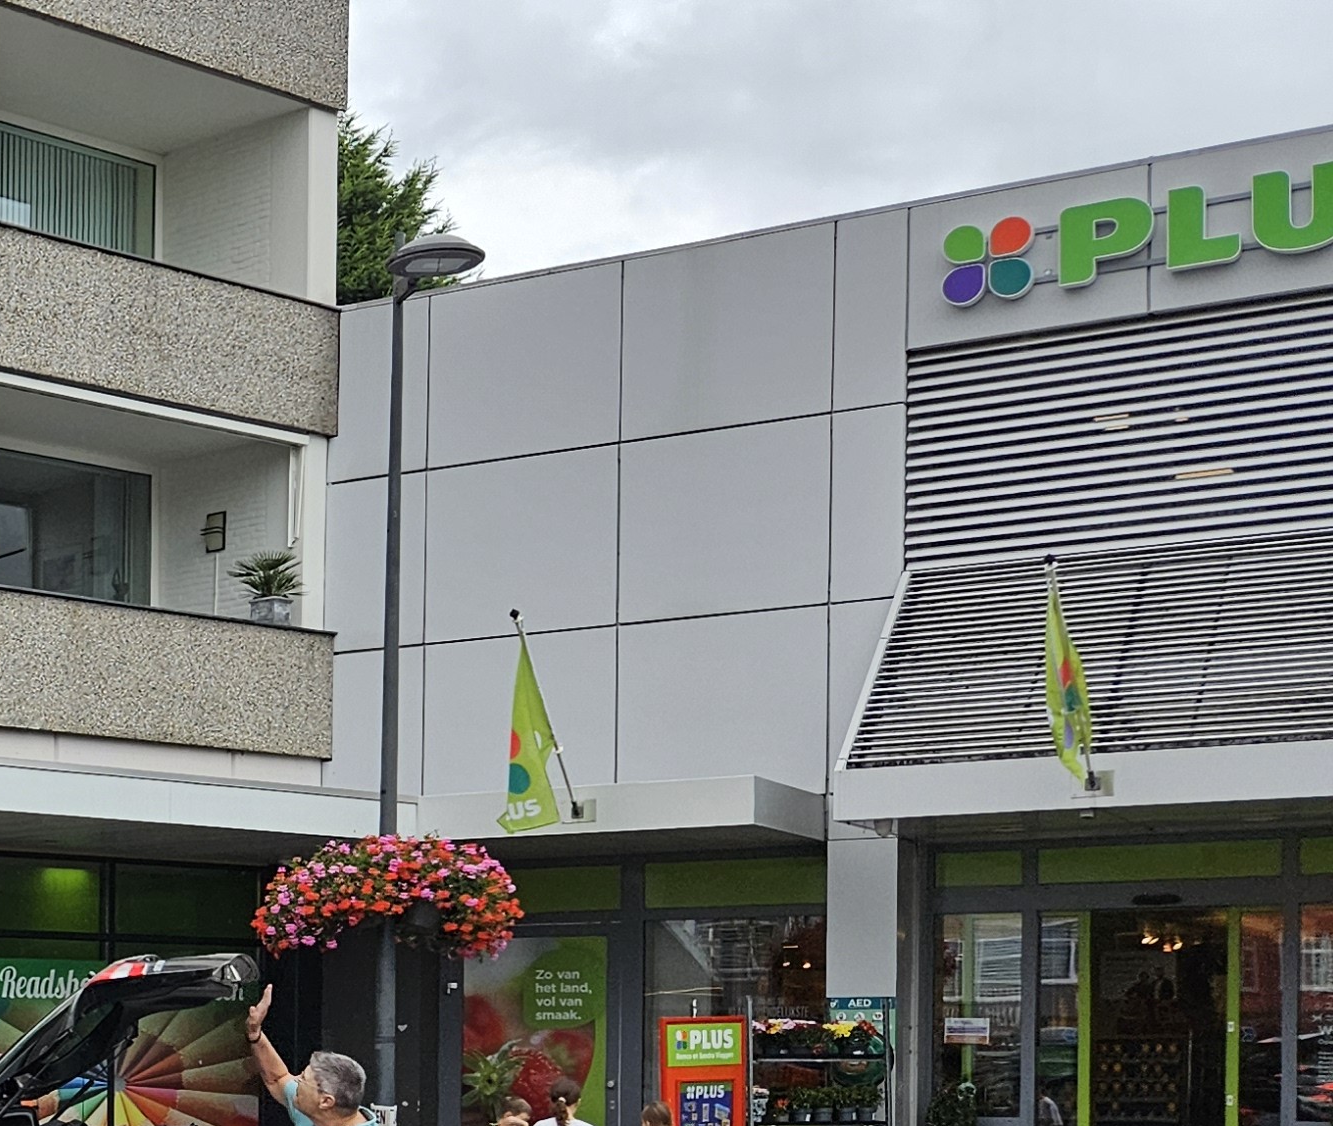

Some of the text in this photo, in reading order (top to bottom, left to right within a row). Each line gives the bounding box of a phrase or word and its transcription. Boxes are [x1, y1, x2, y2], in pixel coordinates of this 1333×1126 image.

[1058, 161, 1333, 289] PLU
[506, 799, 542, 820] US
[535, 969, 580, 980] Zo van
[535, 982, 592, 994] het land,
[535, 996, 582, 1007] vol van
[848, 998, 872, 1008] AED
[535, 1009, 581, 1020] smaak.
[689, 1028, 734, 1050] PLUS
[696, 1085, 725, 1099] PLUS
